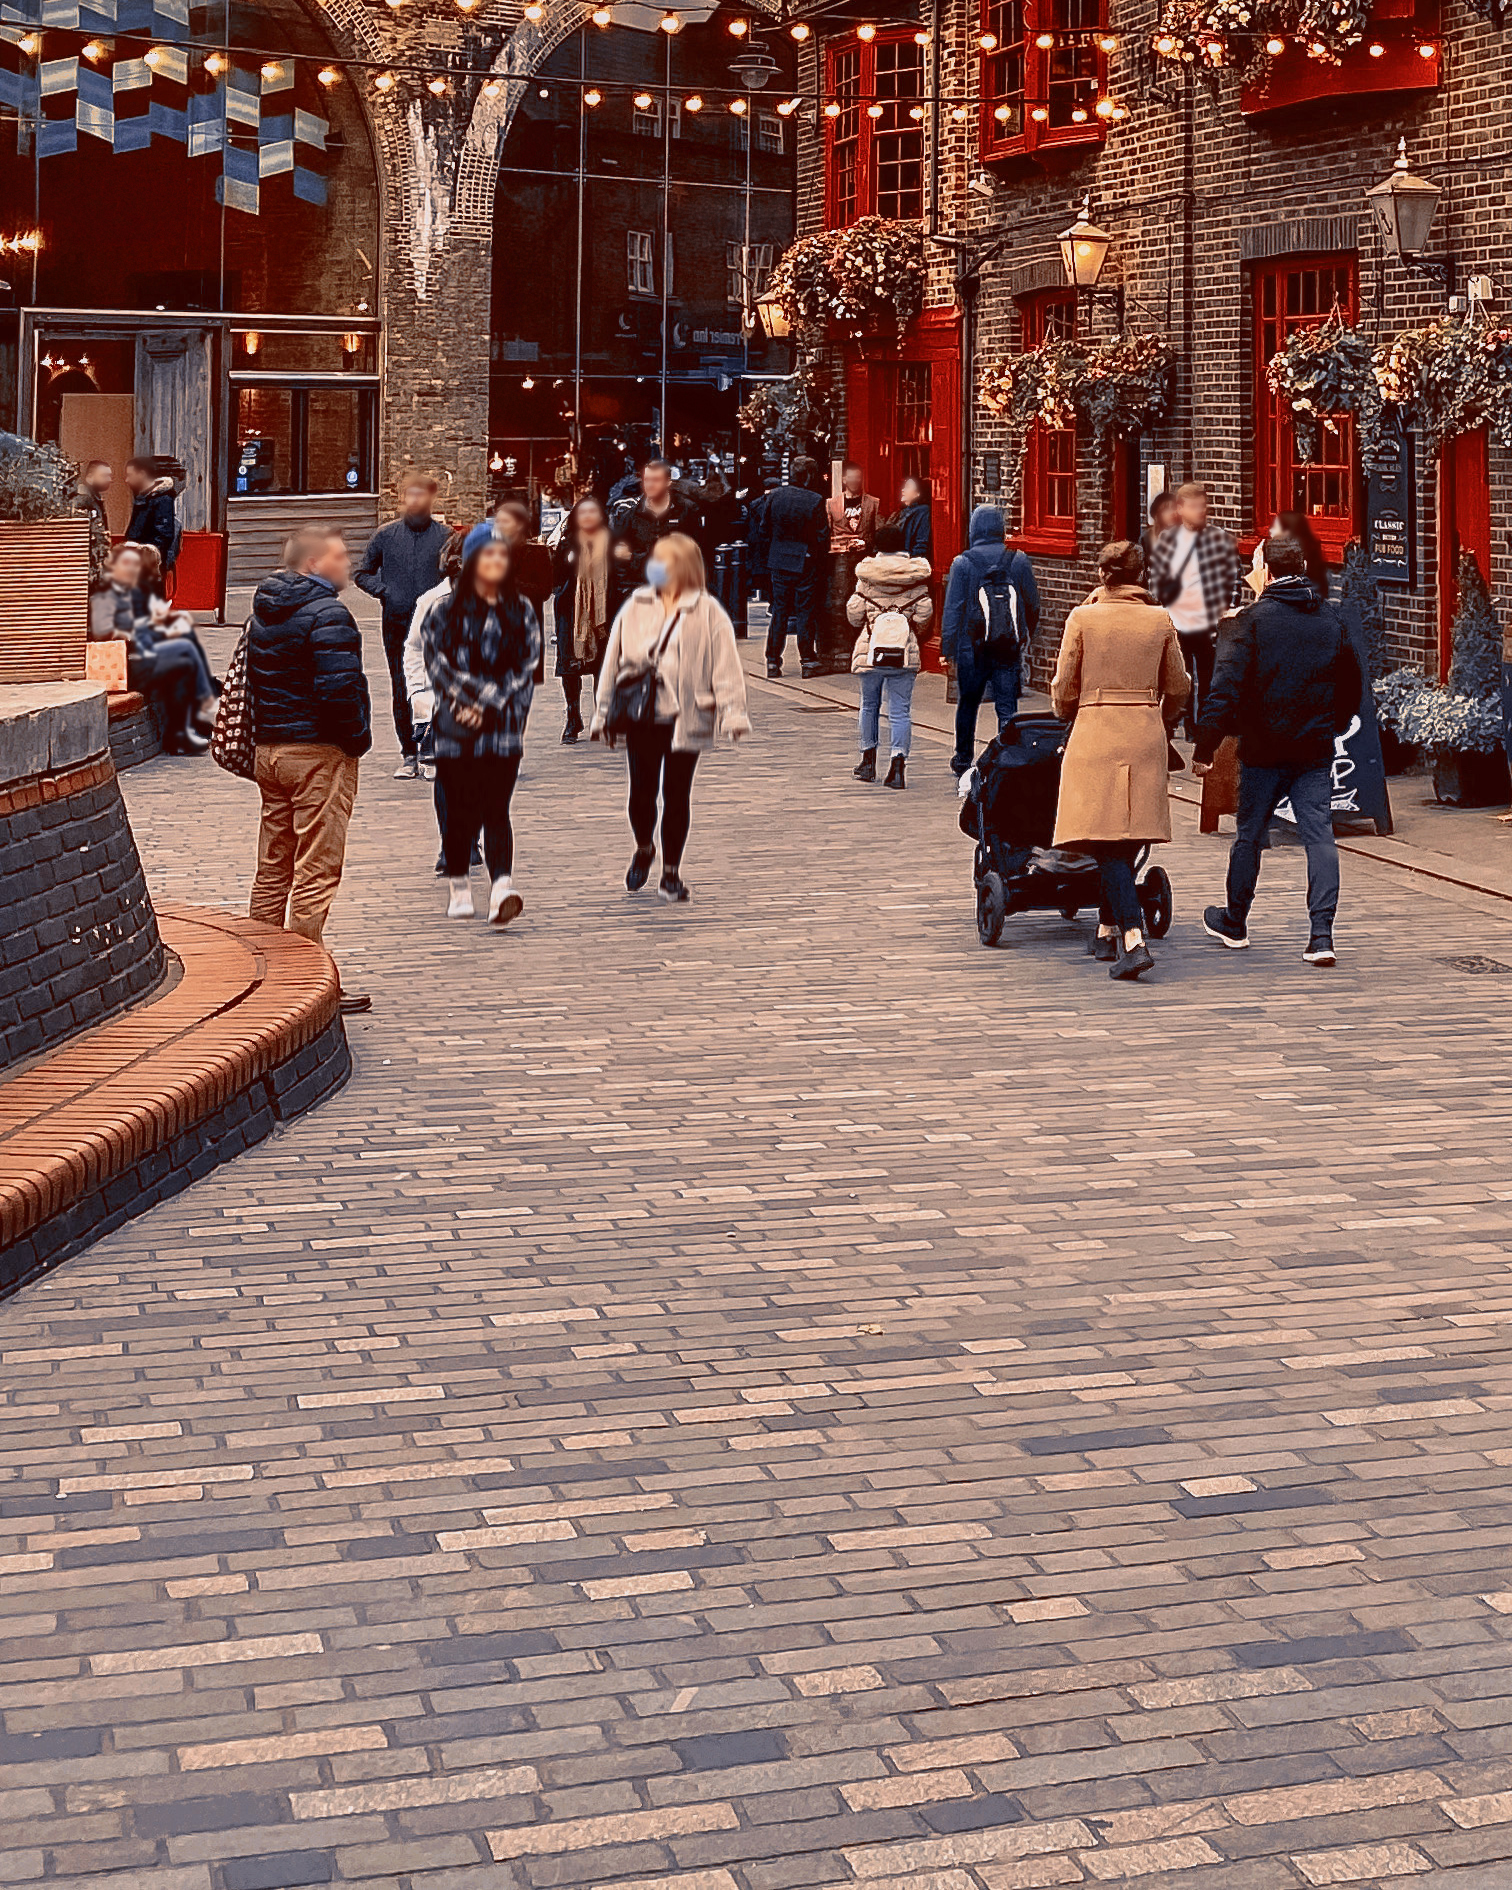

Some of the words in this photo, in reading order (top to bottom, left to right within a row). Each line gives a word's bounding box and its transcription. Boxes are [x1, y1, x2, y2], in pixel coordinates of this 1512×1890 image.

[1374, 519, 1405, 531] CLASSIC
[1375, 543, 1386, 554] PUB
[1387, 544, 1404, 555] FOOD
